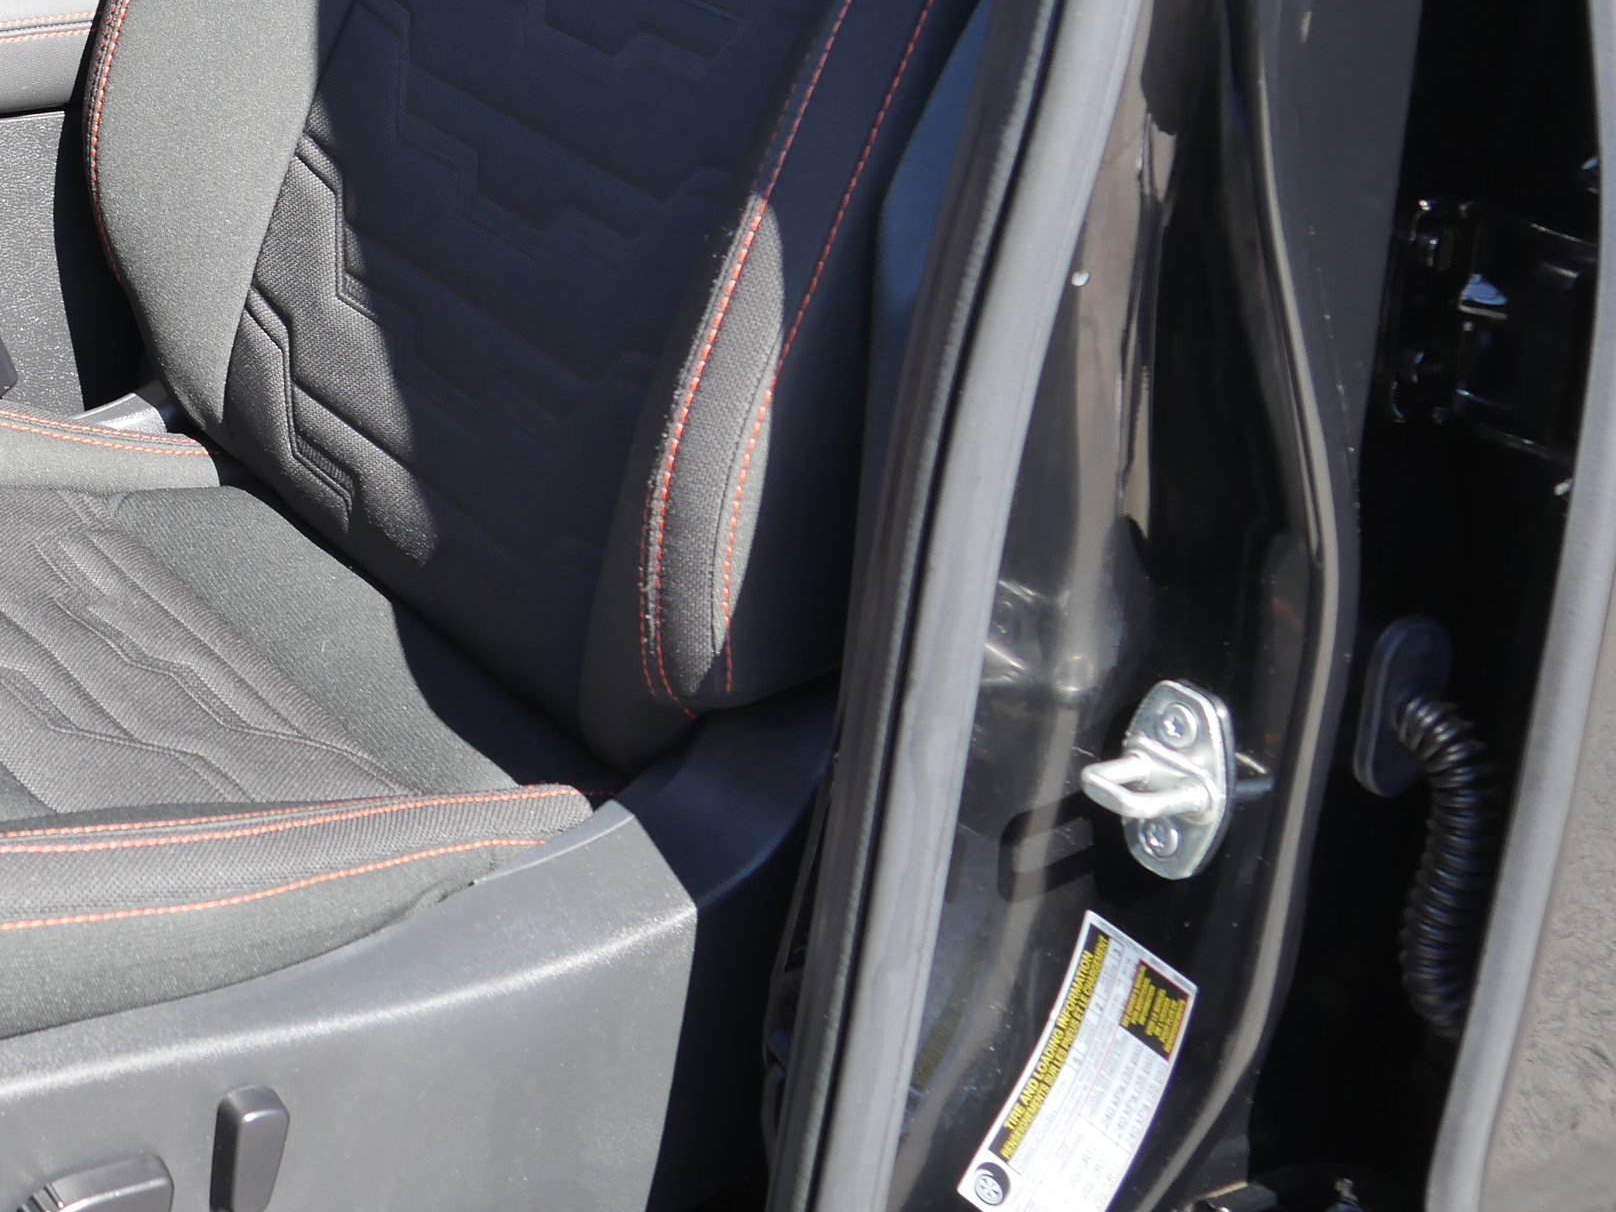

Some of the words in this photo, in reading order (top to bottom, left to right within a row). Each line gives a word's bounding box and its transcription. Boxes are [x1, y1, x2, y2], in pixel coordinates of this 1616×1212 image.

[1004, 1102, 1026, 1129] TIRE
[1018, 1076, 1039, 1105] AND
[1031, 1027, 1065, 1080] LOADING
[1056, 949, 1093, 1029] INFORMATION
